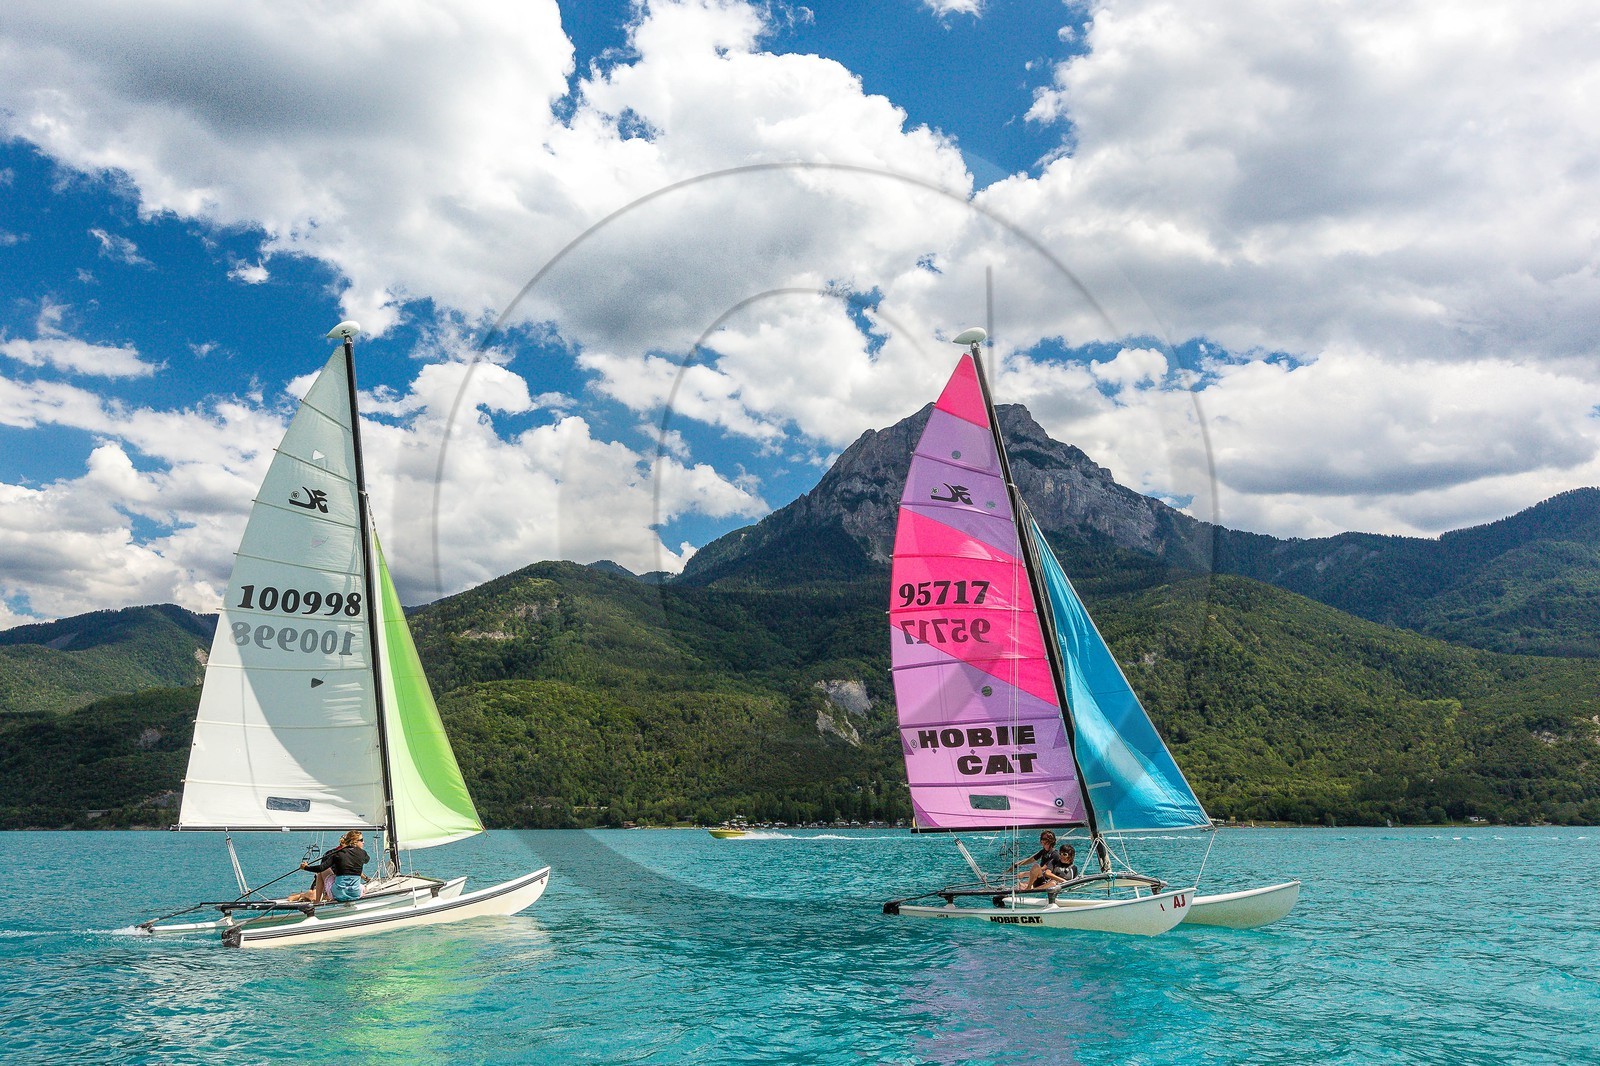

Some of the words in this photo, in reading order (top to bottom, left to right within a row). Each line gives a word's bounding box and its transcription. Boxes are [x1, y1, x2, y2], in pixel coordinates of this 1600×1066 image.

[237, 585, 362, 616] 100998
[899, 580, 990, 607] 95717
[917, 725, 1036, 749] HOBIE
[956, 752, 1038, 776] CAT
[1173, 894, 1187, 909] AJ
[989, 916, 1019, 924] HOBIE
[1020, 916, 1040, 924] CAT
